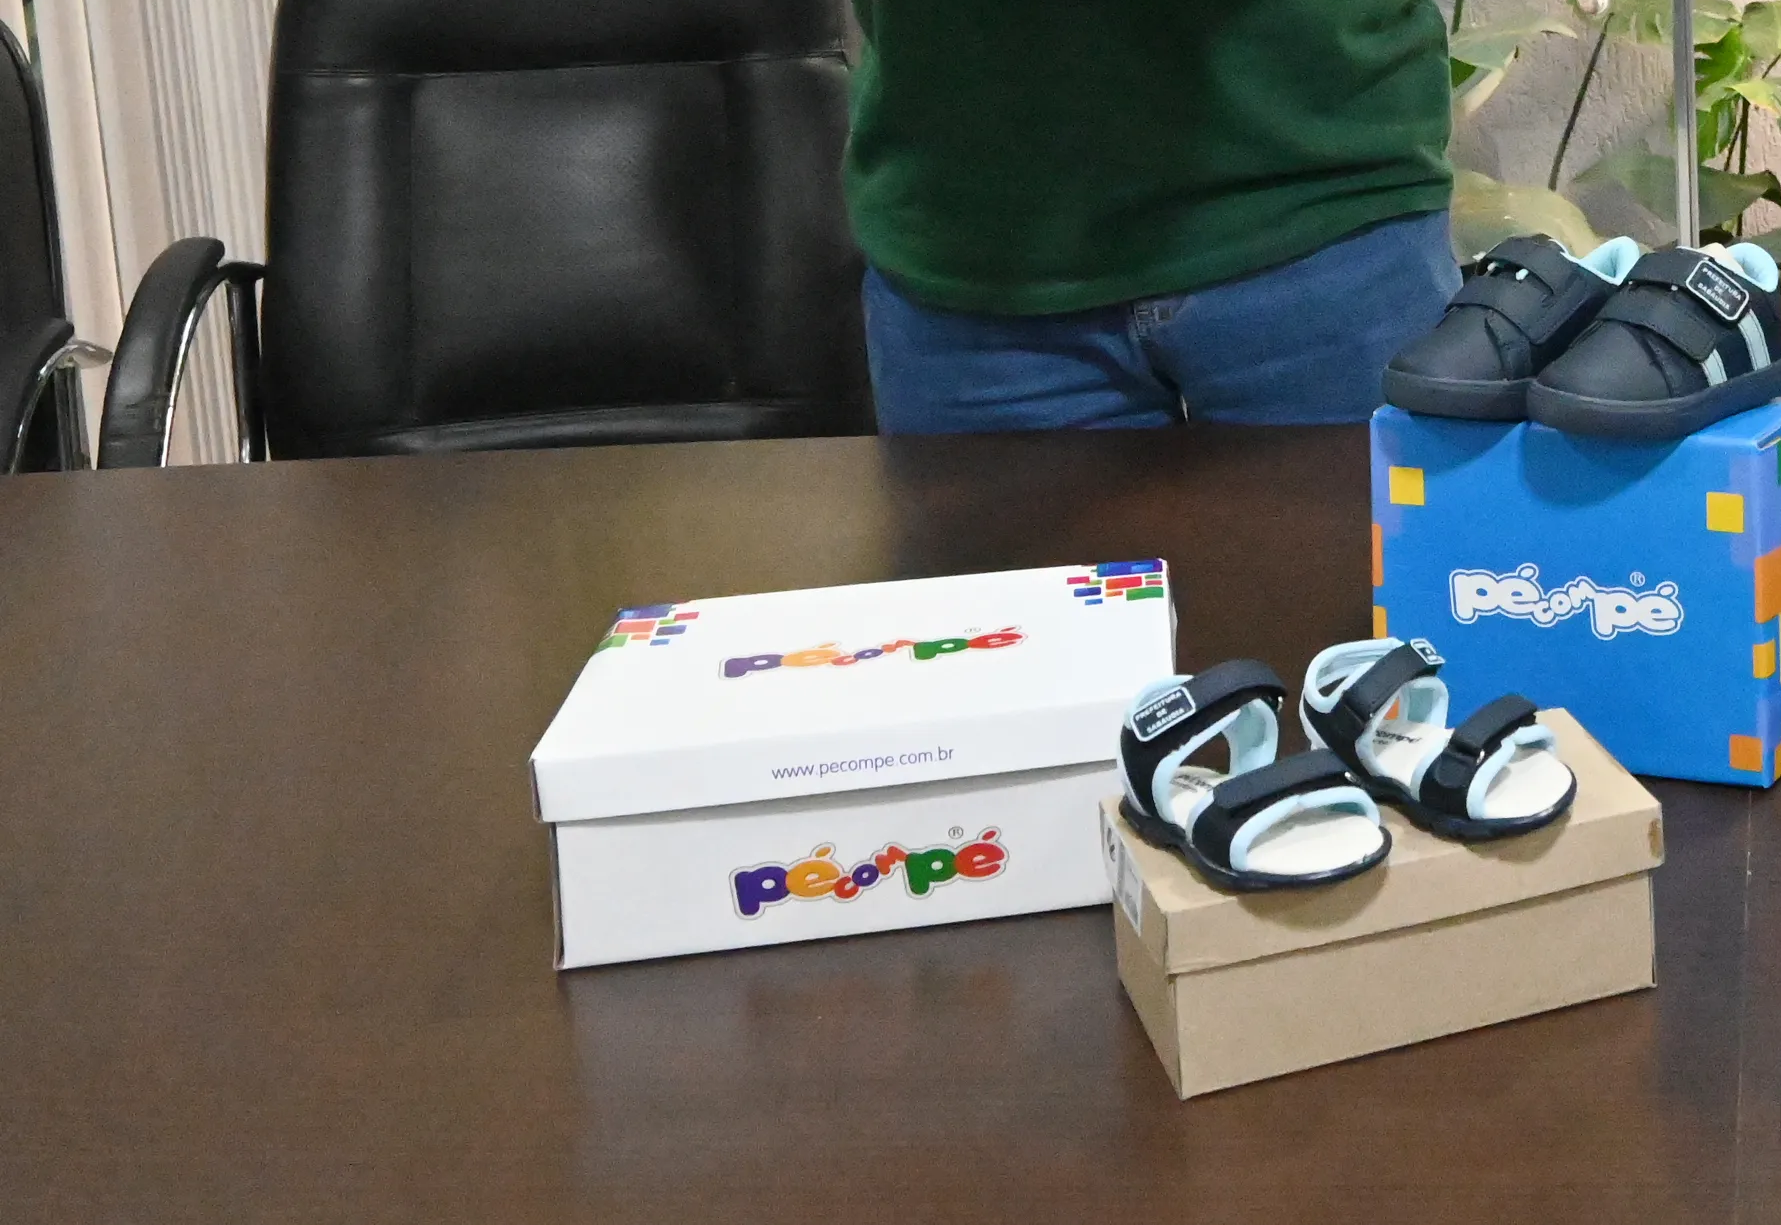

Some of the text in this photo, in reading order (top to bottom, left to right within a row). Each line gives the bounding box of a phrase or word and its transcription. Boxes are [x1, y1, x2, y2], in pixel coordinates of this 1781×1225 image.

[1702, 267, 1741, 301] PREFEITURA
[1135, 691, 1182, 721] PREFEITURA
[771, 746, 954, 780] www.pecompe.com.br
